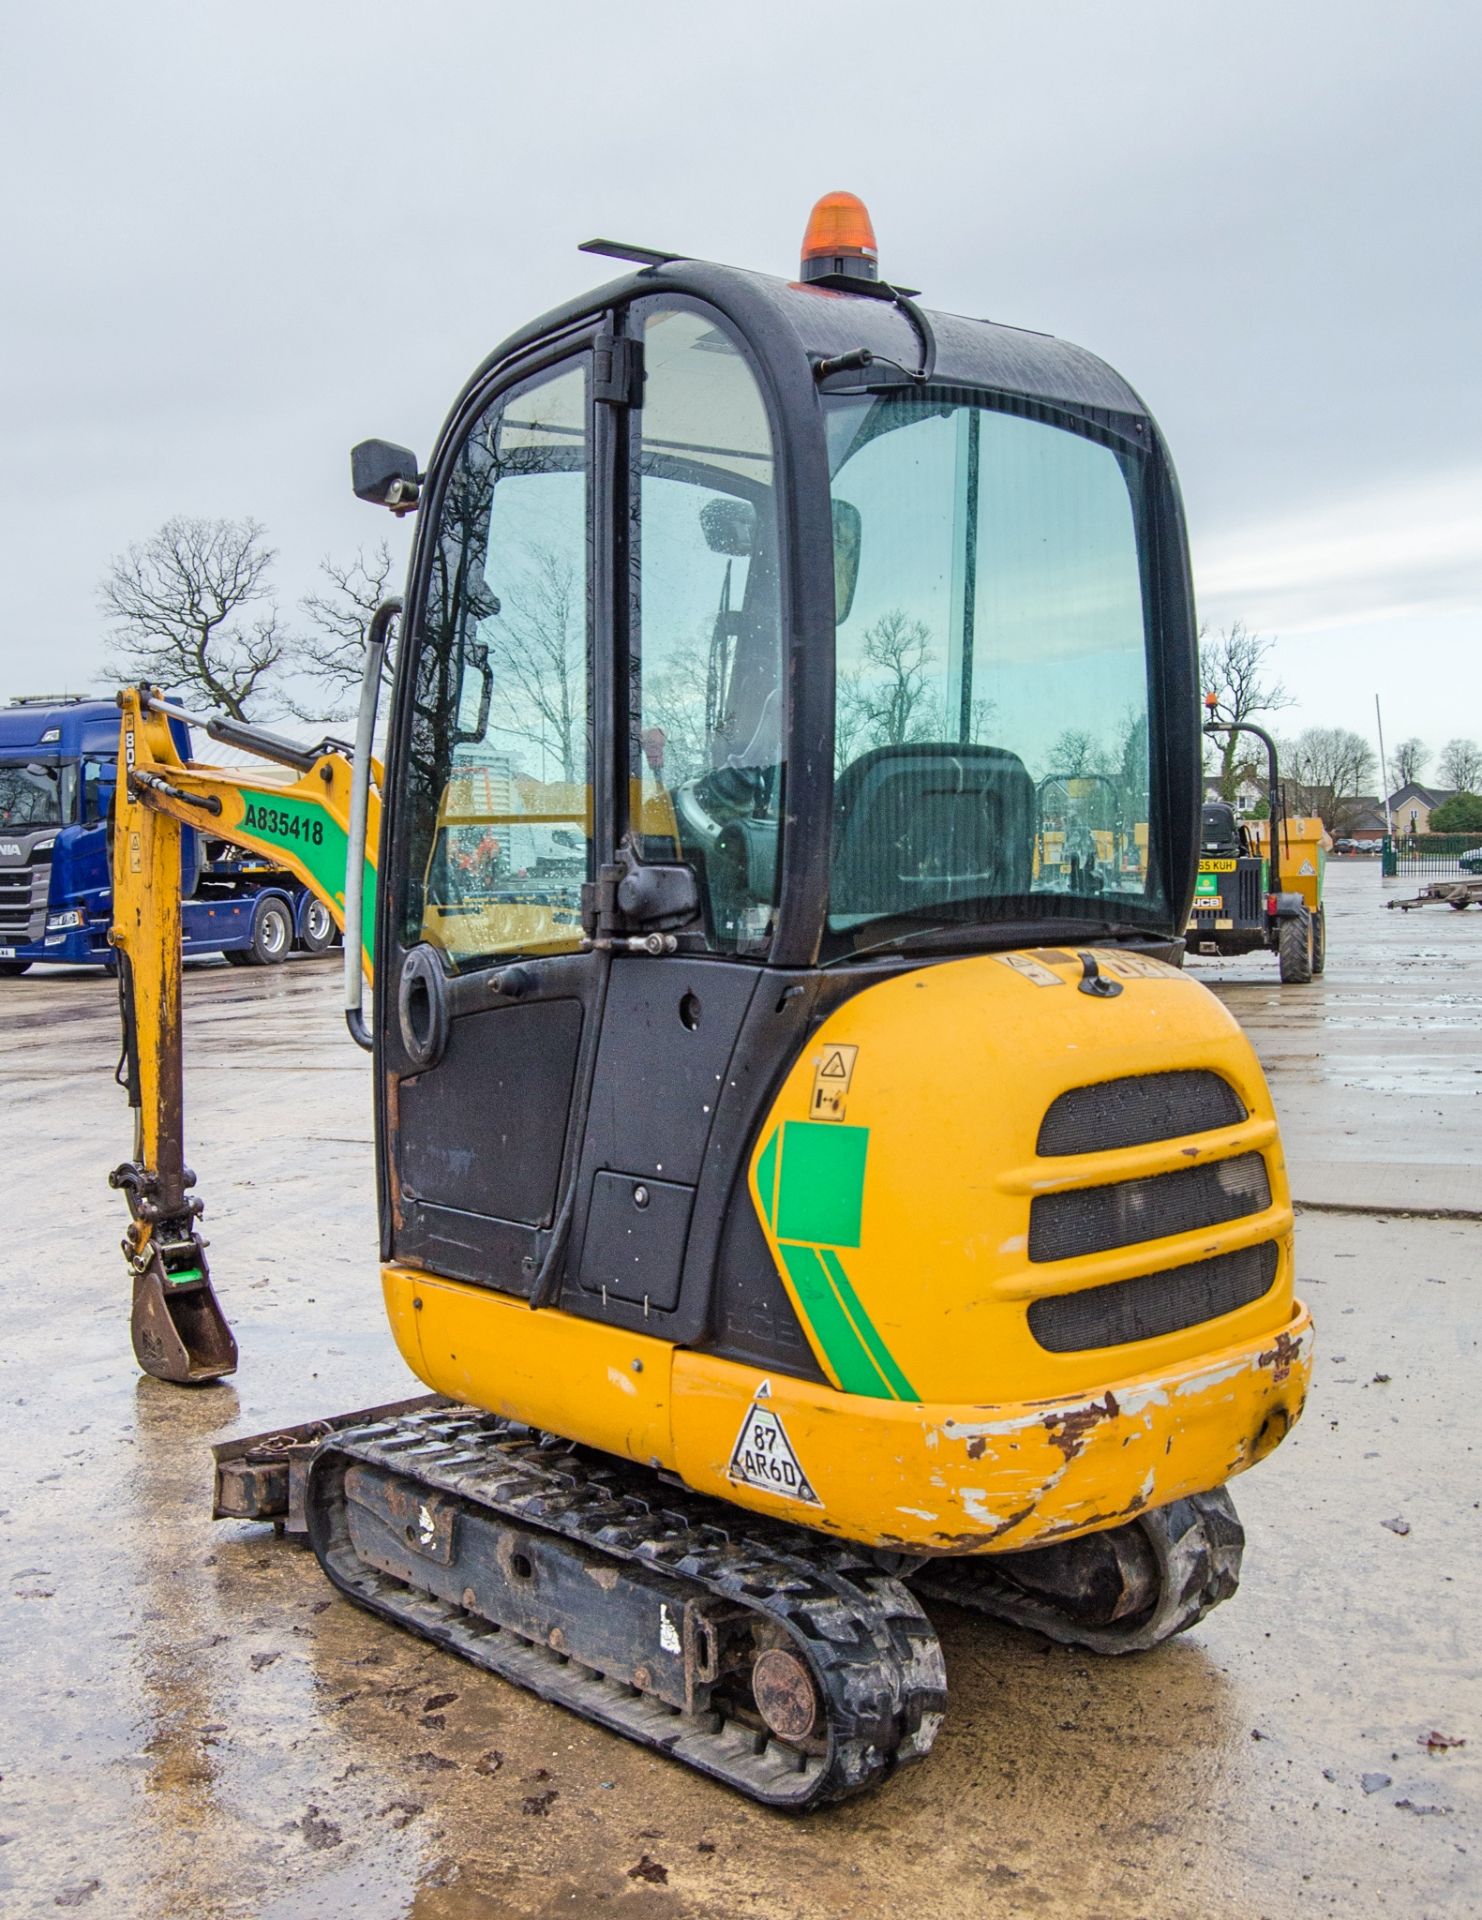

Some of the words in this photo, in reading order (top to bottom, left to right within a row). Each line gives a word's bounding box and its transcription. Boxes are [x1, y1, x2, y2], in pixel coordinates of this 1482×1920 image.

[244, 803, 324, 846] A835418
[1213, 861, 1232, 870] KUH
[1192, 898, 1219, 907] JCB
[753, 1424, 777, 1454] 87
[744, 1449, 797, 1487] AR6D
